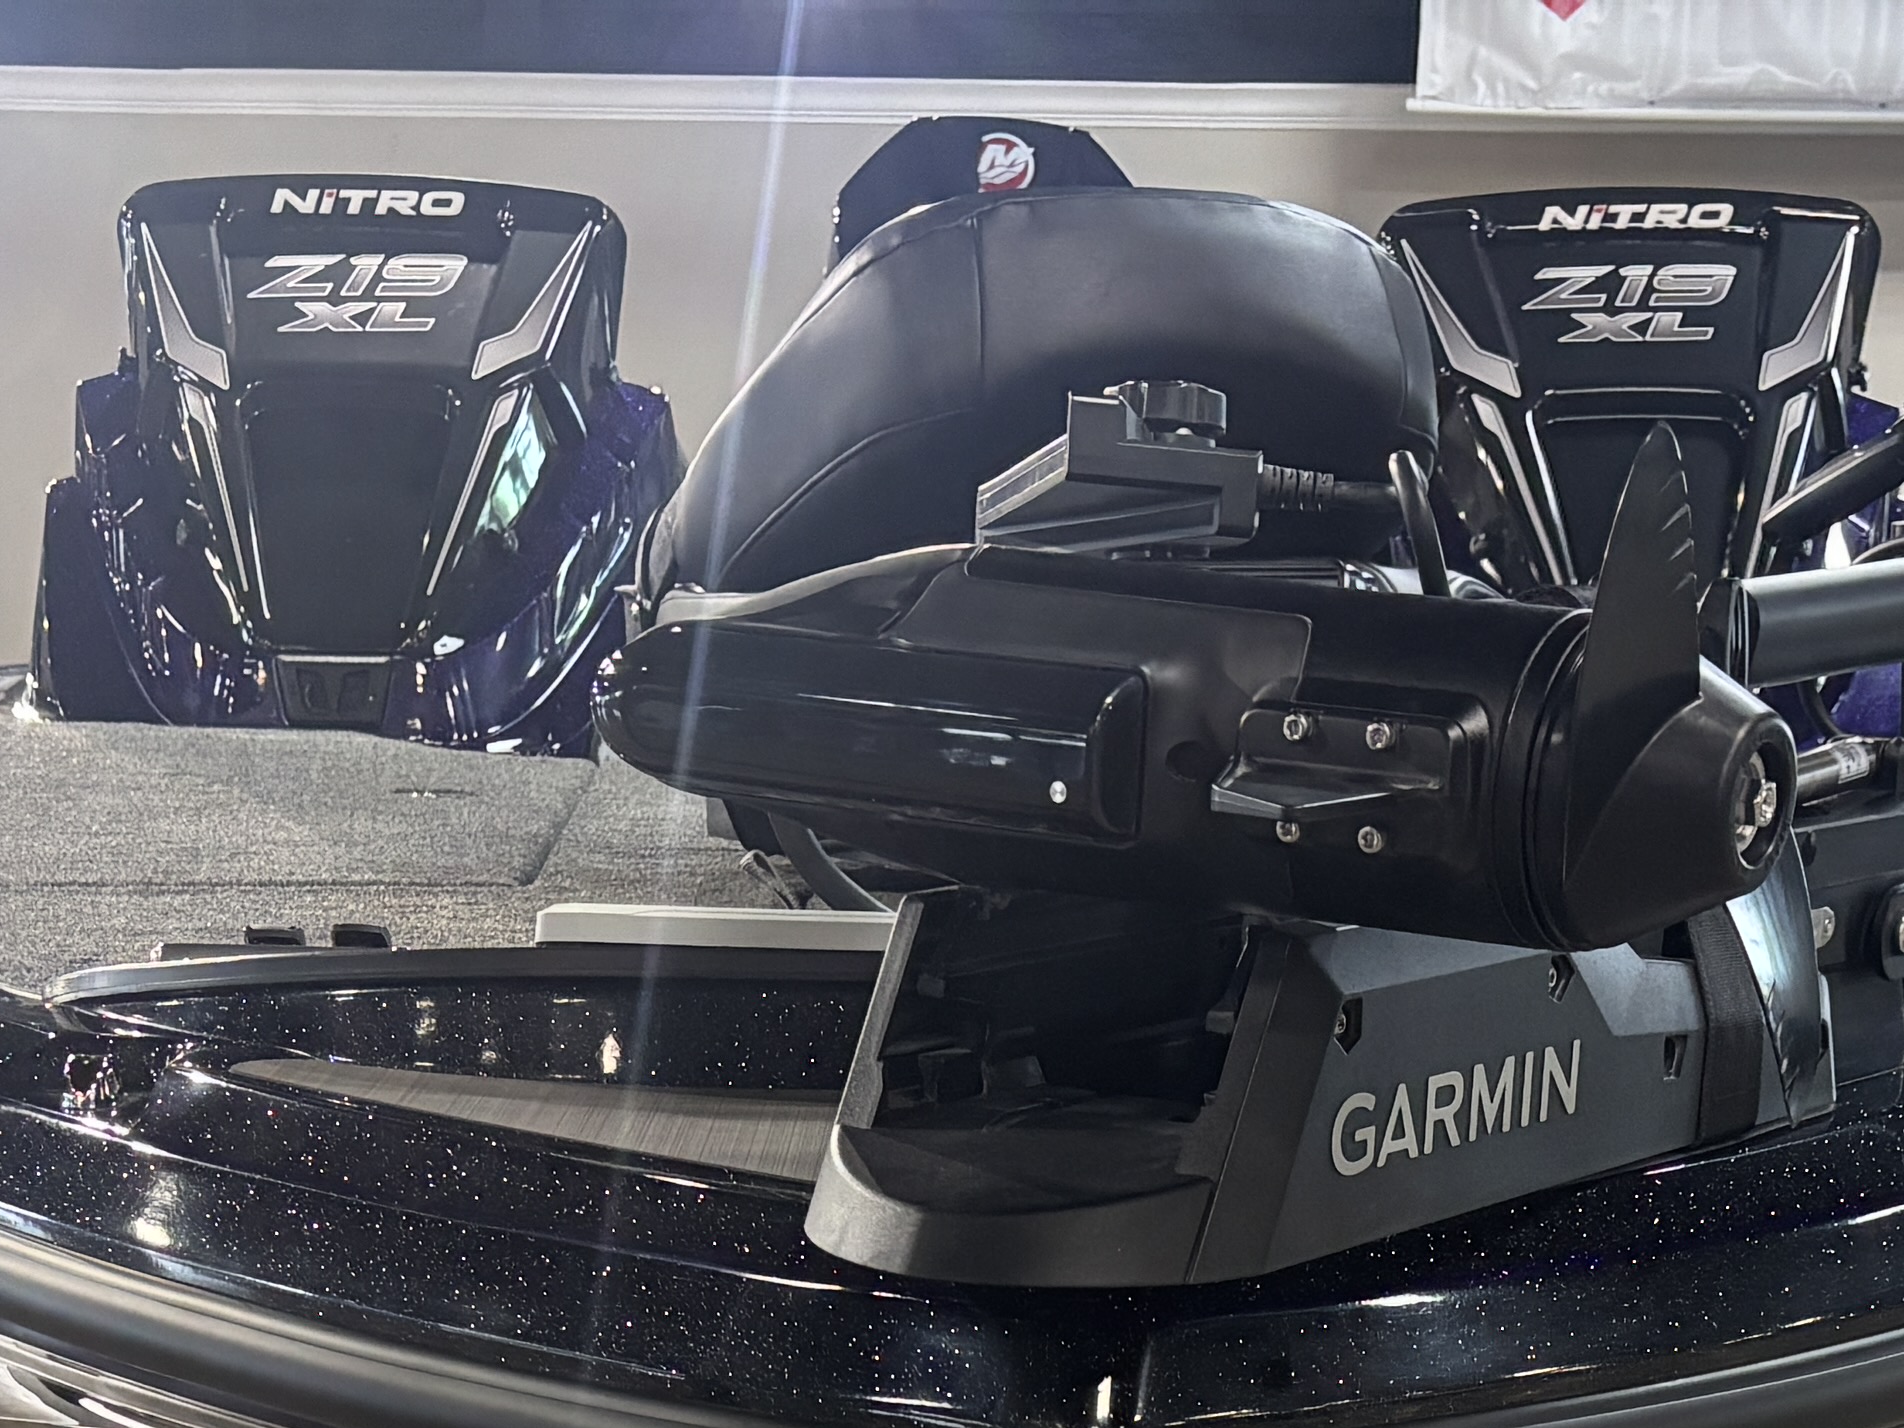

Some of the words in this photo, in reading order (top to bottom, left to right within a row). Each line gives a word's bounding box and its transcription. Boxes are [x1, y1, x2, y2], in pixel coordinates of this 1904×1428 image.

[270, 188, 465, 216] NITRO
[1538, 203, 1734, 231] NITRO
[247, 254, 468, 298] Z19
[1521, 264, 1737, 310] Z19
[277, 302, 436, 332] XL
[1557, 312, 1714, 342] XL
[1331, 1038, 1581, 1176] GARMIN
